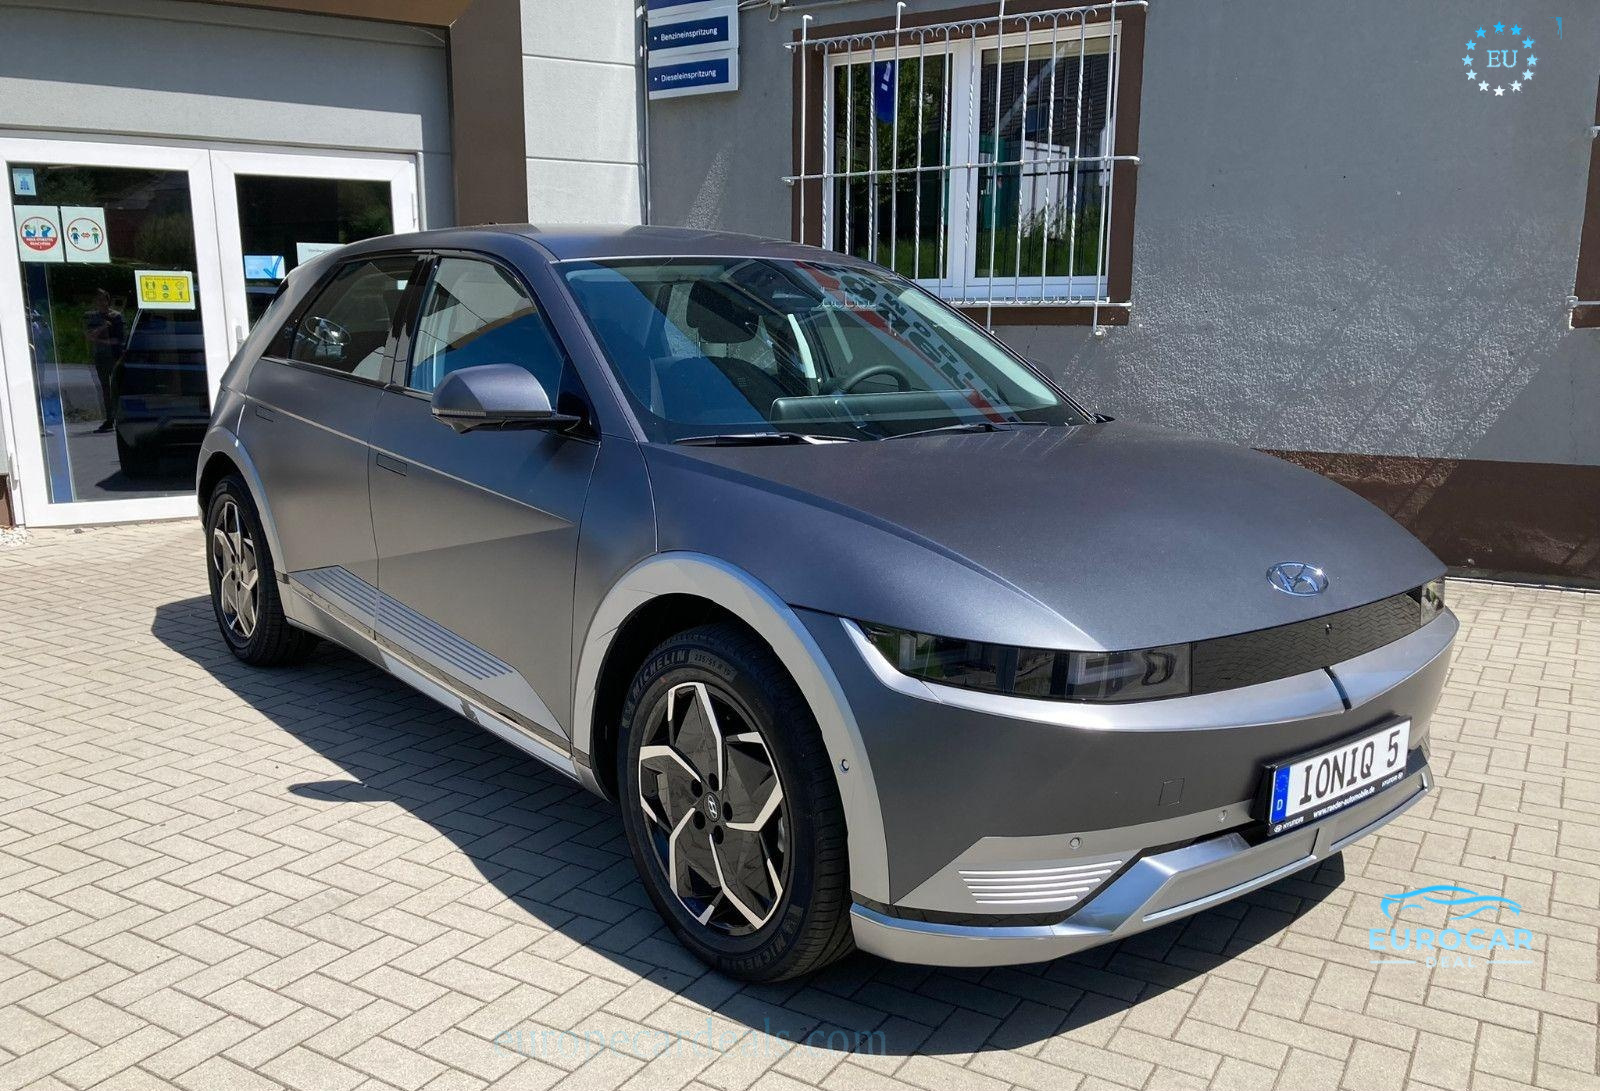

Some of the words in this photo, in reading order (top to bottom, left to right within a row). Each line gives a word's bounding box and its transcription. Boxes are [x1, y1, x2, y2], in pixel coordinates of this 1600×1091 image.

[660, 27, 718, 41] Benzineinspritzung
[660, 69, 717, 82] Dieseleinspritzung
[632, 649, 687, 698] MICHELIN
[1299, 741, 1375, 805] IONIQ
[1386, 730, 1400, 768] 5
[1276, 799, 1283, 811] D
